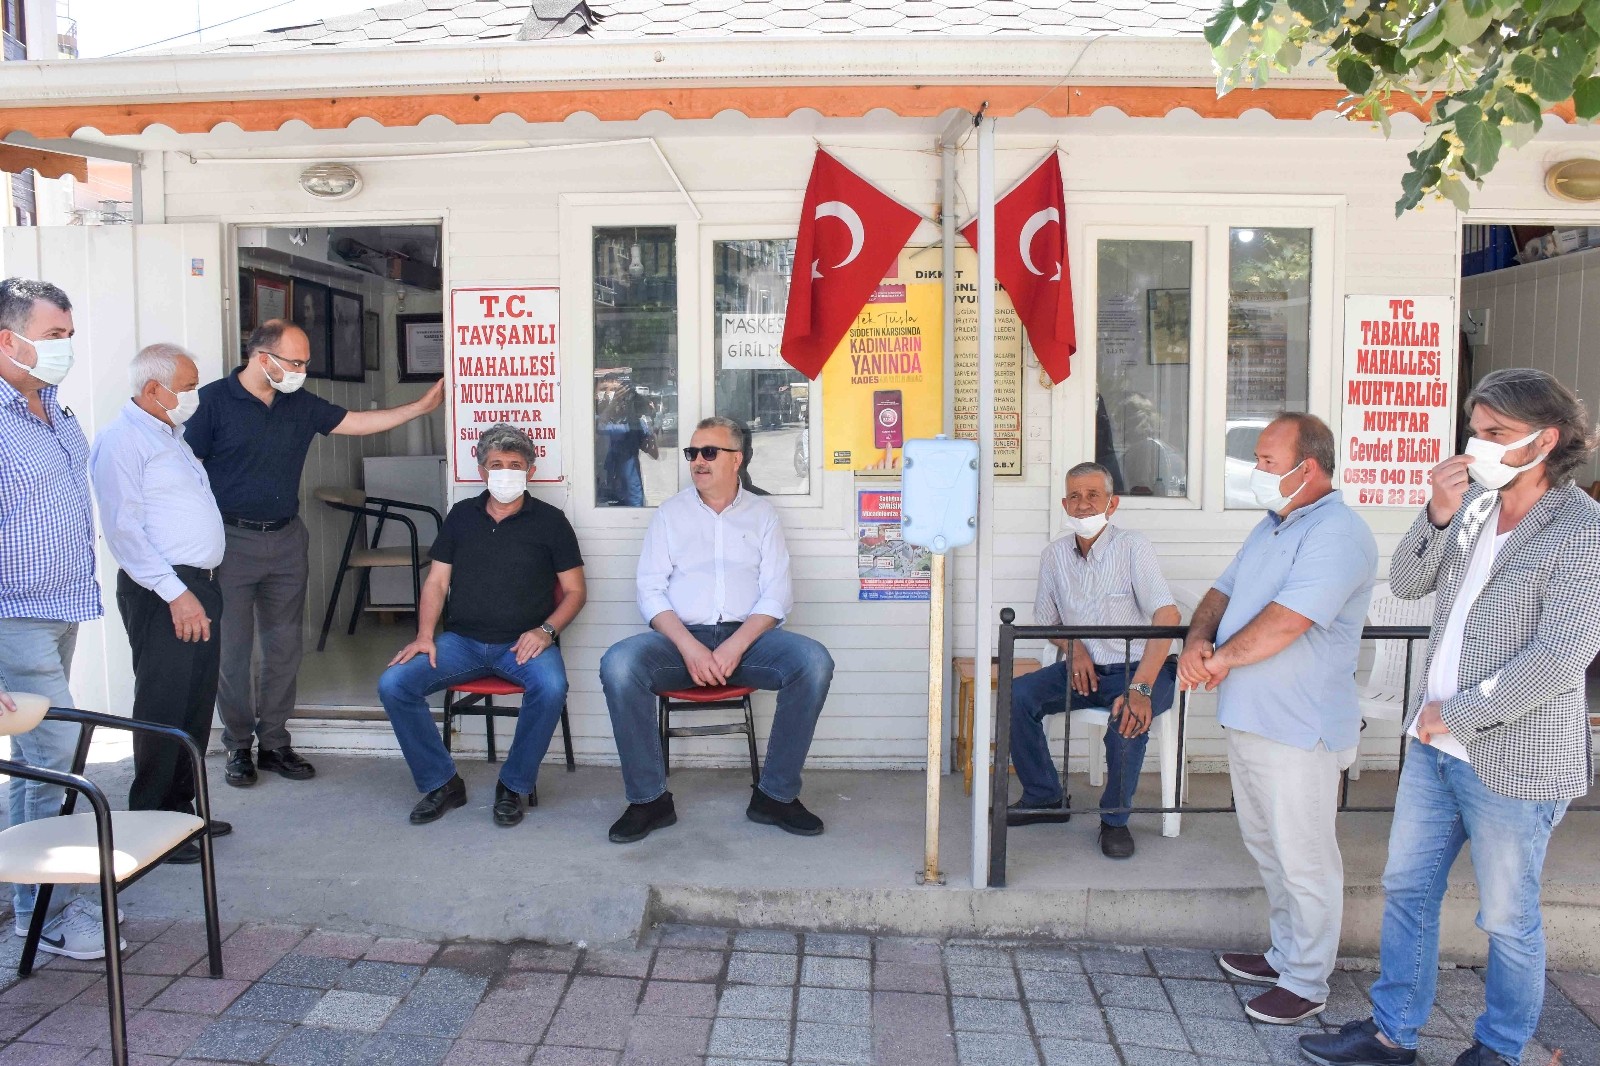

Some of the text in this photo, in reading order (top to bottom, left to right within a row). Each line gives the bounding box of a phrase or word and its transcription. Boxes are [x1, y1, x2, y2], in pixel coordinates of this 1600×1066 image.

[480, 295, 533, 318] T.C.
[1389, 299, 1414, 320] TC
[458, 324, 556, 350] TAVŞANLI
[850, 336, 922, 354] KADINLARIN
[1360, 320, 1440, 347] TABAKLAR
[458, 351, 556, 377] MAHALLESİ
[851, 353, 922, 375] YANINDA
[851, 375, 879, 385] KADES
[460, 380, 554, 404] MUHTARLIĞI
[1347, 378, 1448, 407] MUHTARLIĞI
[473, 409, 543, 423] MUHTAR
[1363, 410, 1430, 433] MUHTAR
[1349, 436, 1393, 463] Cevdet
[1343, 467, 1377, 485] 0535
[1380, 468, 1406, 485] 040
[1409, 469, 1423, 485] 15
[1387, 488, 1405, 504] 23
[1408, 488, 1426, 505] 29
